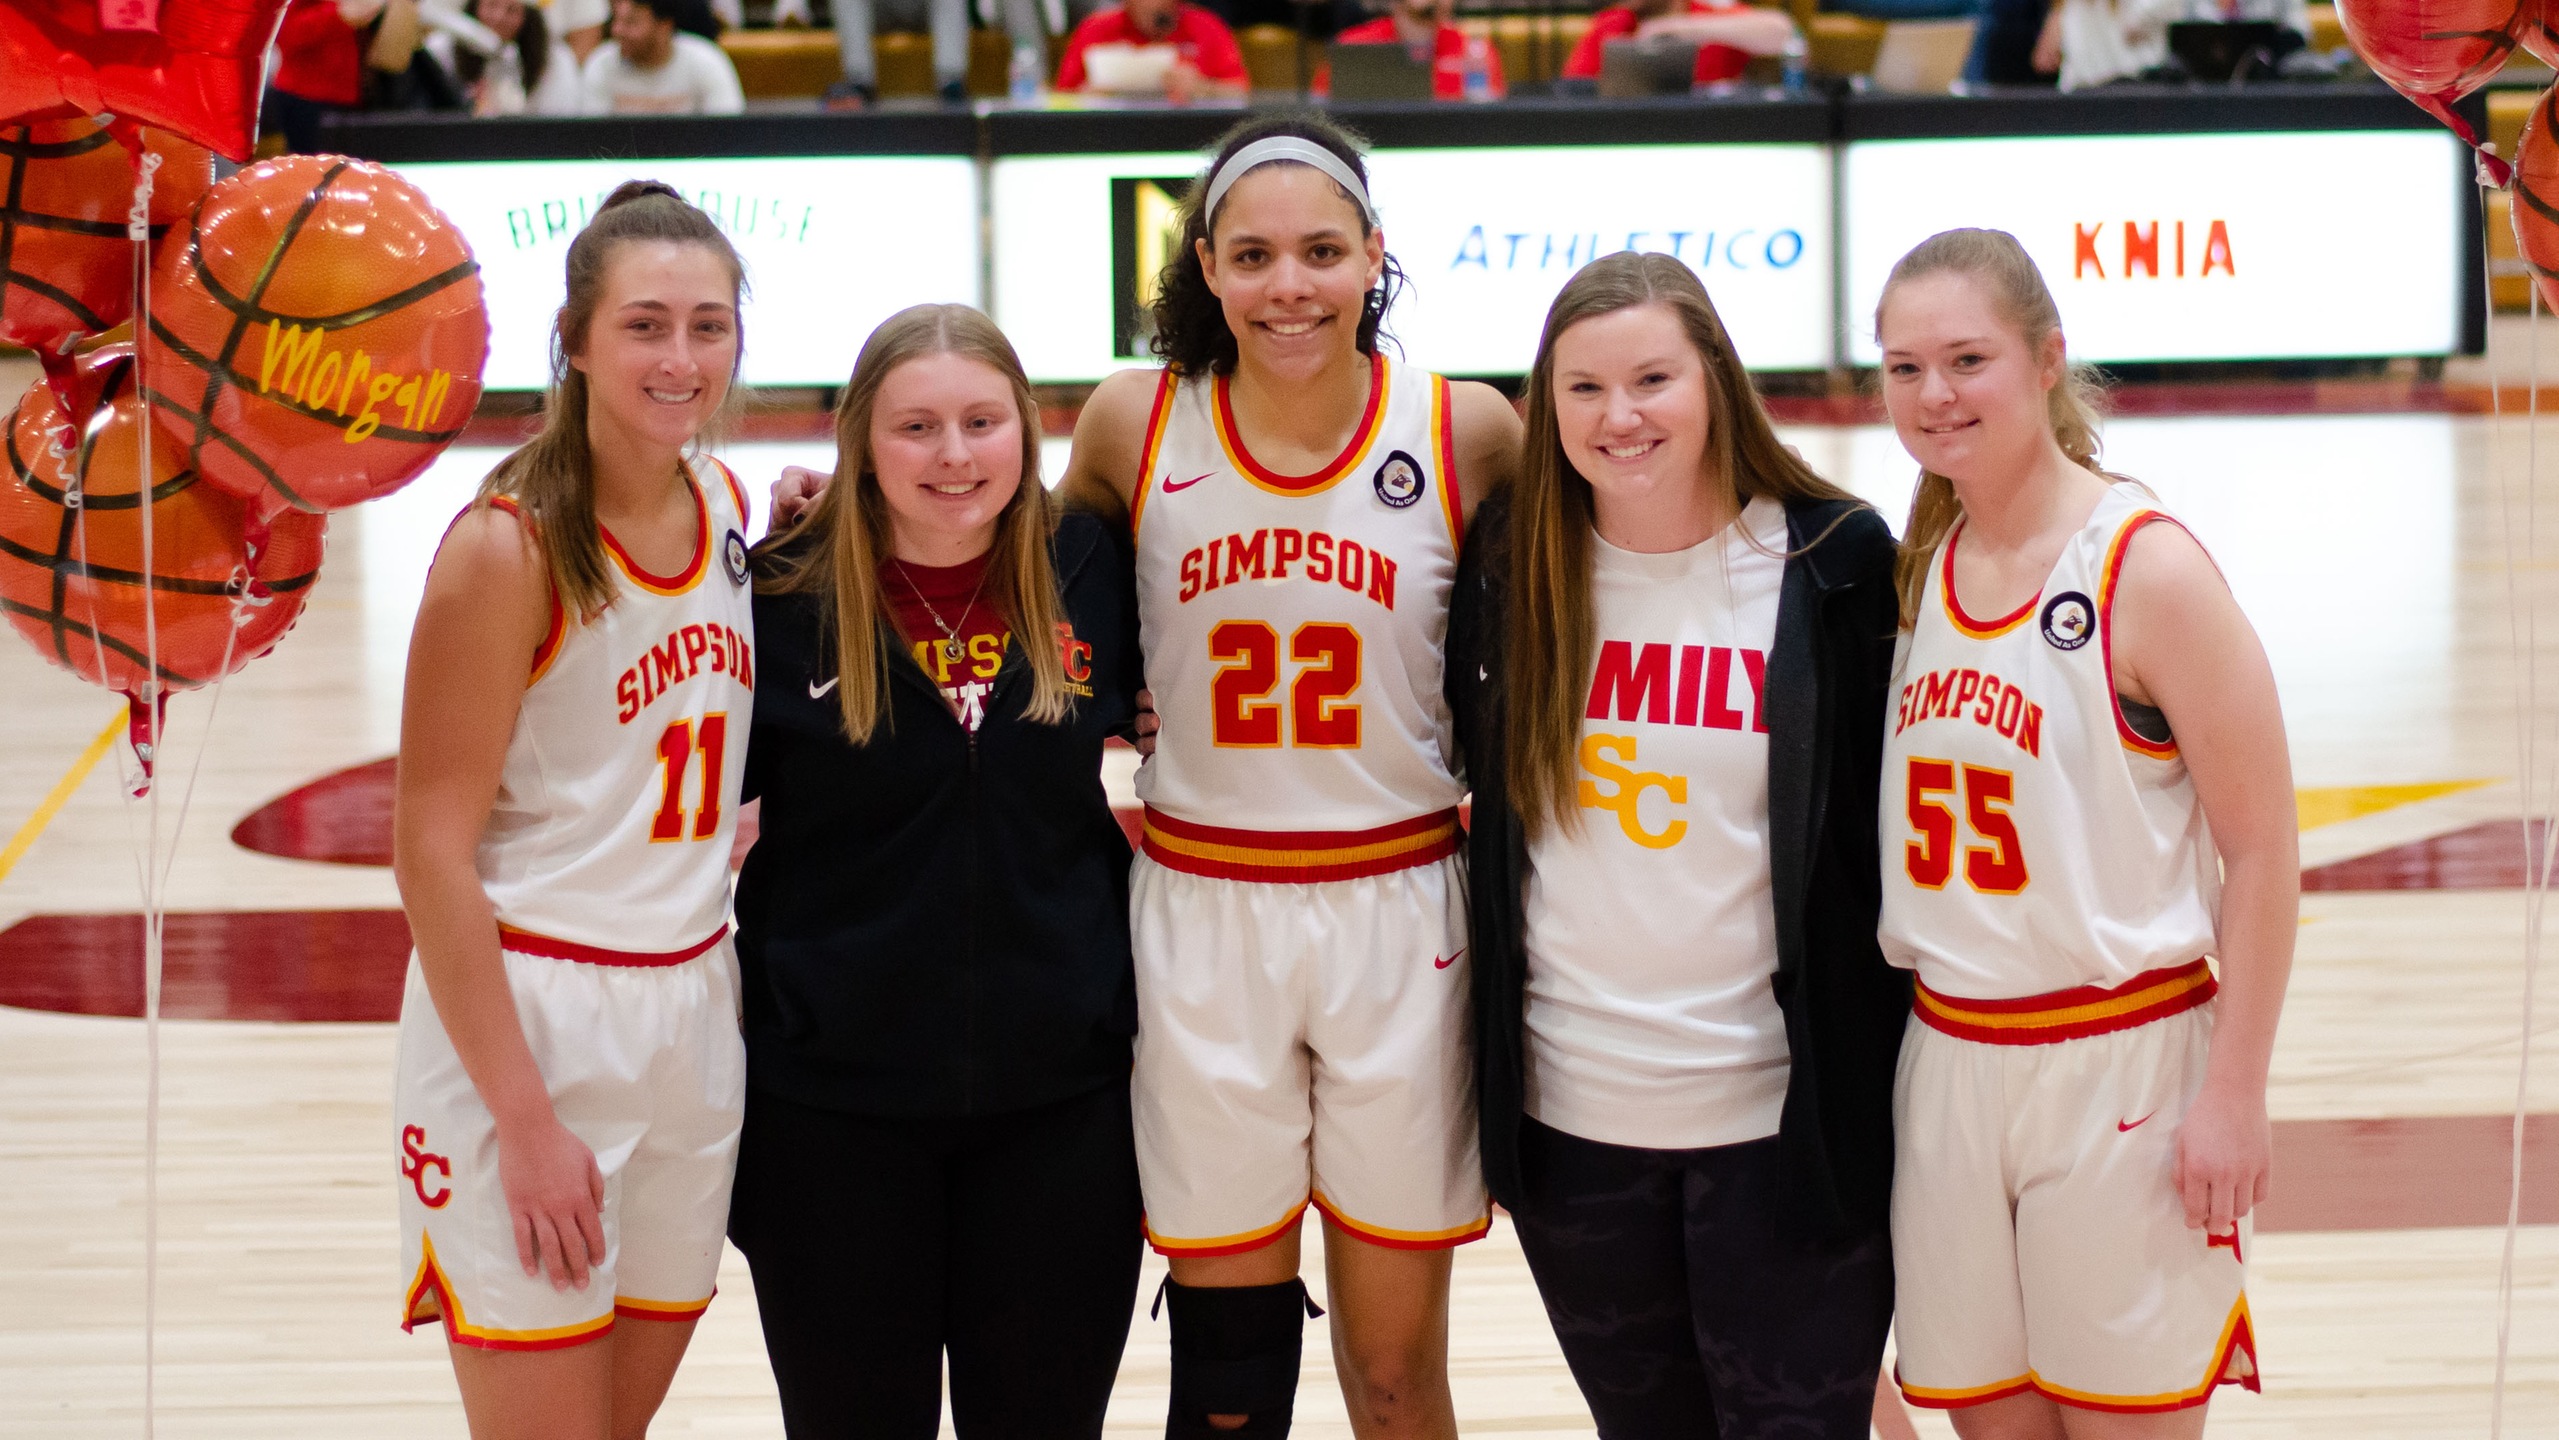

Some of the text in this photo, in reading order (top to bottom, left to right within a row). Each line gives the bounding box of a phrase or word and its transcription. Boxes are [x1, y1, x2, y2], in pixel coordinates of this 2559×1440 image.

[2074, 220, 2235, 279] KNIA
[261, 318, 451, 444] Morgan
[1179, 528, 1398, 613] SIMPSON
[616, 622, 753, 726] SIMPSON
[1207, 619, 1363, 749] 22
[1895, 668, 2044, 760] SIMPSON
[648, 711, 728, 843] 11
[1577, 733, 1689, 850] SC
[1904, 756, 2031, 896] 55
[401, 1124, 452, 1210] SC
